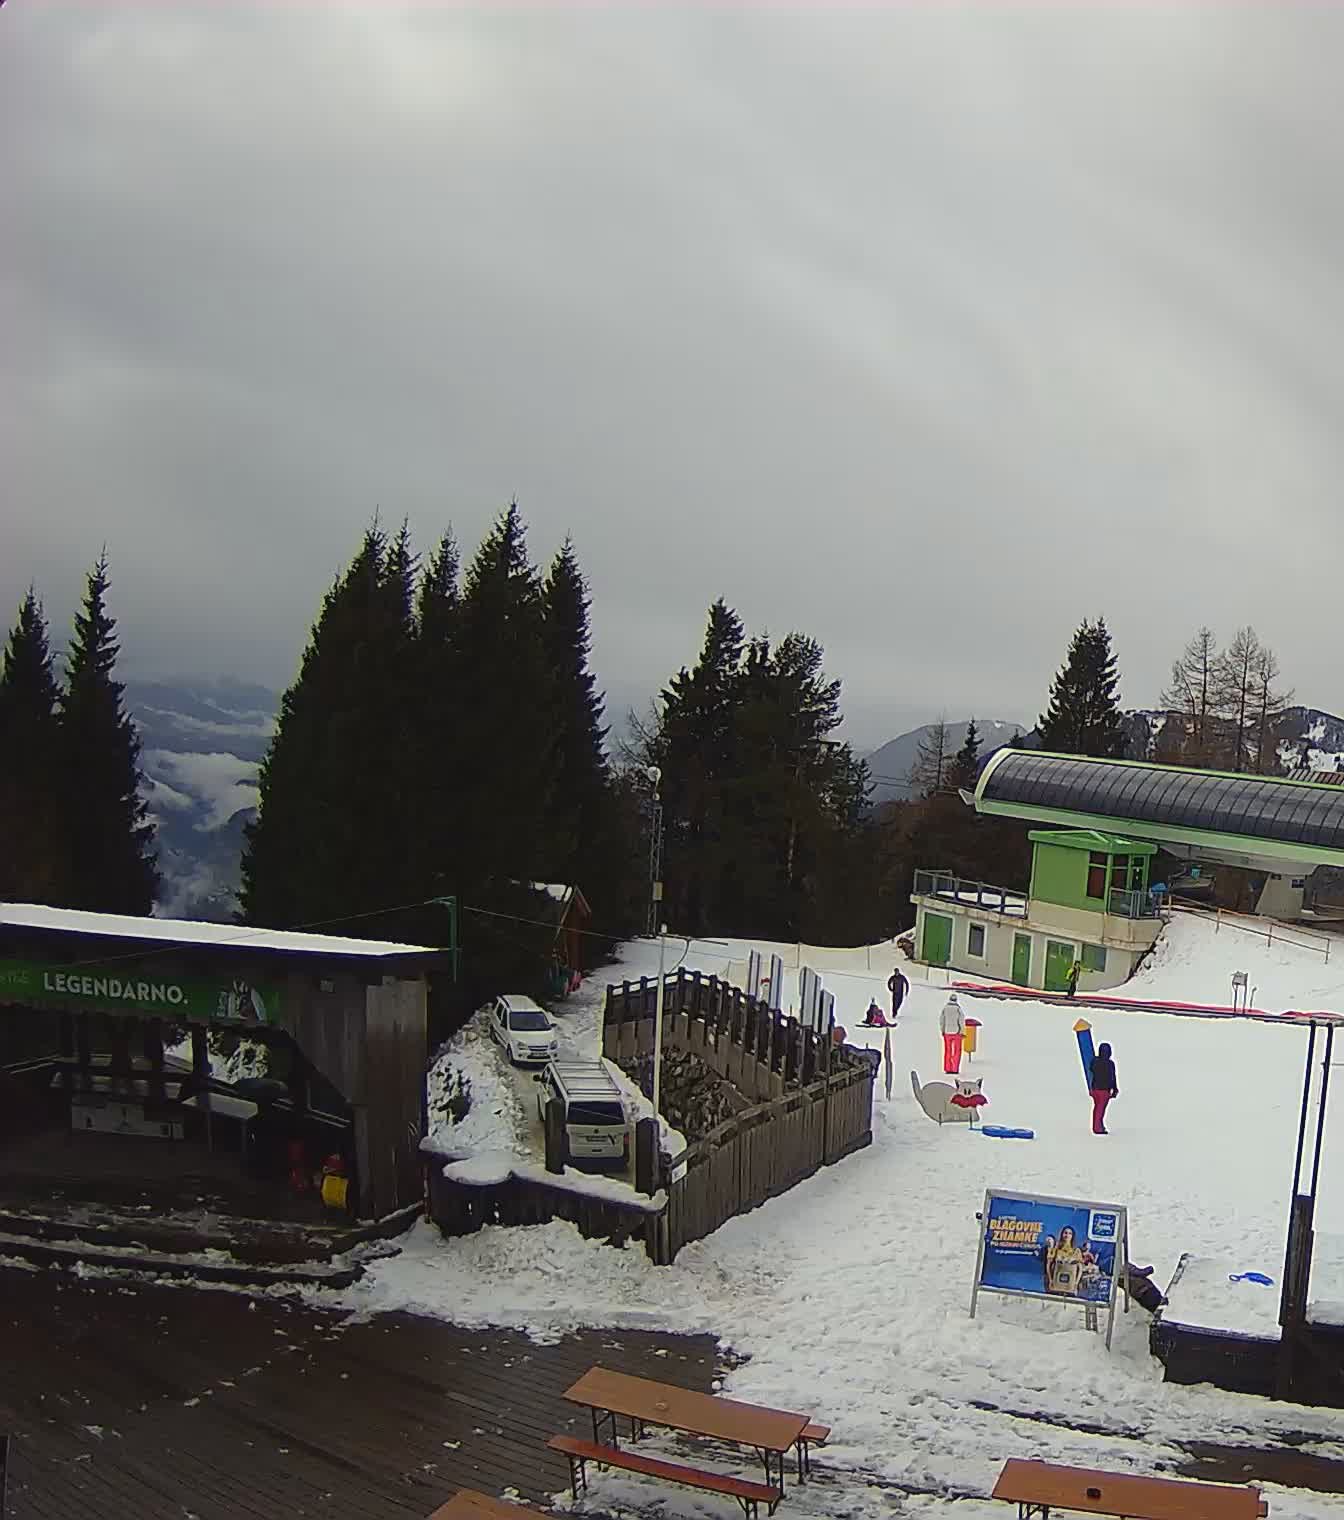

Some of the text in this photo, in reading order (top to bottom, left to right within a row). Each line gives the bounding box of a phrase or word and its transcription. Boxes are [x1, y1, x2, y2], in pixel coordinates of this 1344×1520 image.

[43, 972, 189, 1005] LEGENDARNO.
[990, 1219, 1043, 1233] BLAGOVNE
[992, 1230, 1039, 1243] ZNAMKE
